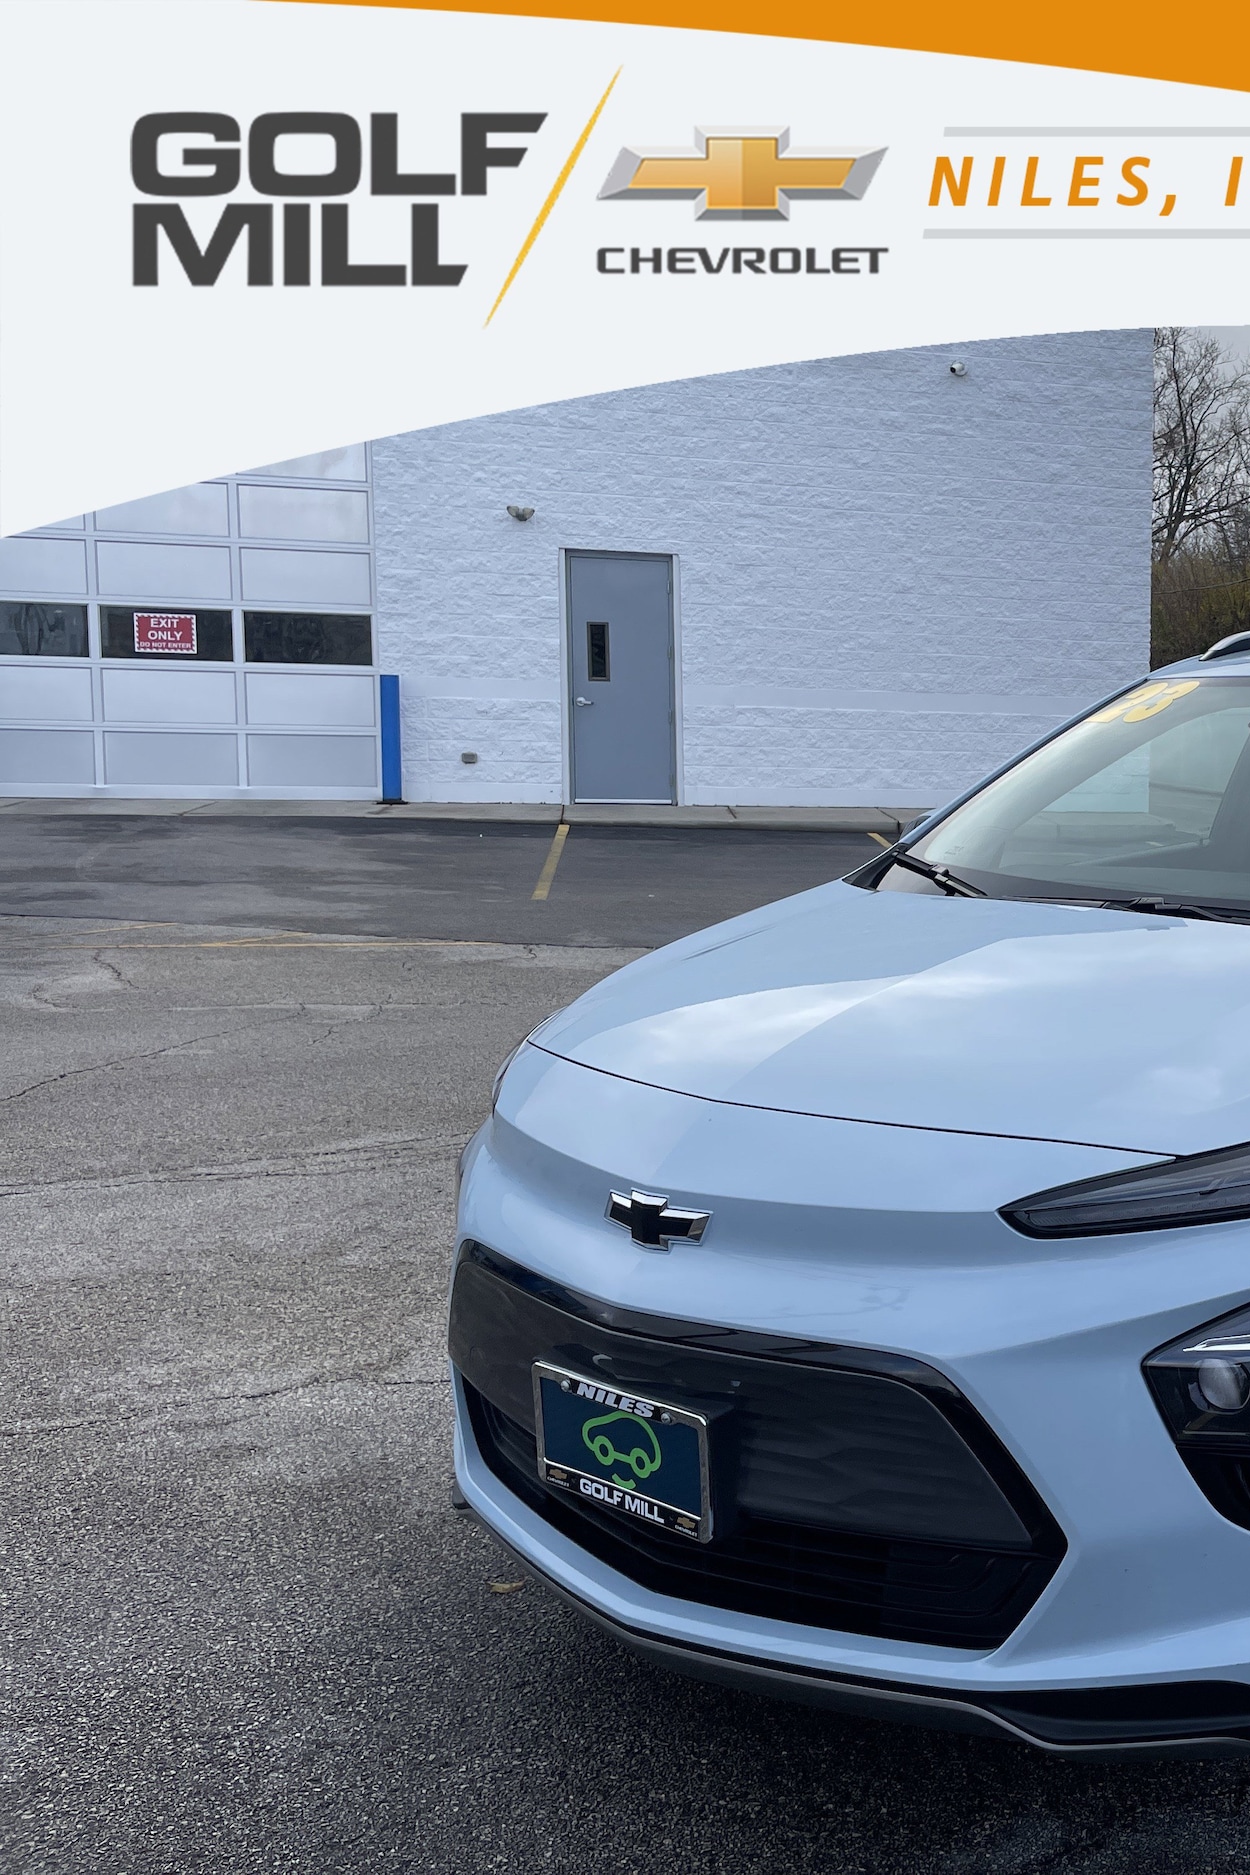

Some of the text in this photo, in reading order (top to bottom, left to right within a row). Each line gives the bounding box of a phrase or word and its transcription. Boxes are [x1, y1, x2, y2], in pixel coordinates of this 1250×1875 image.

[147, 630, 183, 641] ONLY
[151, 618, 179, 628] EXIT
[1084, 680, 1200, 723] 23
[576, 1382, 655, 1418] NILES
[579, 1478, 665, 1524] GOLF MILL
